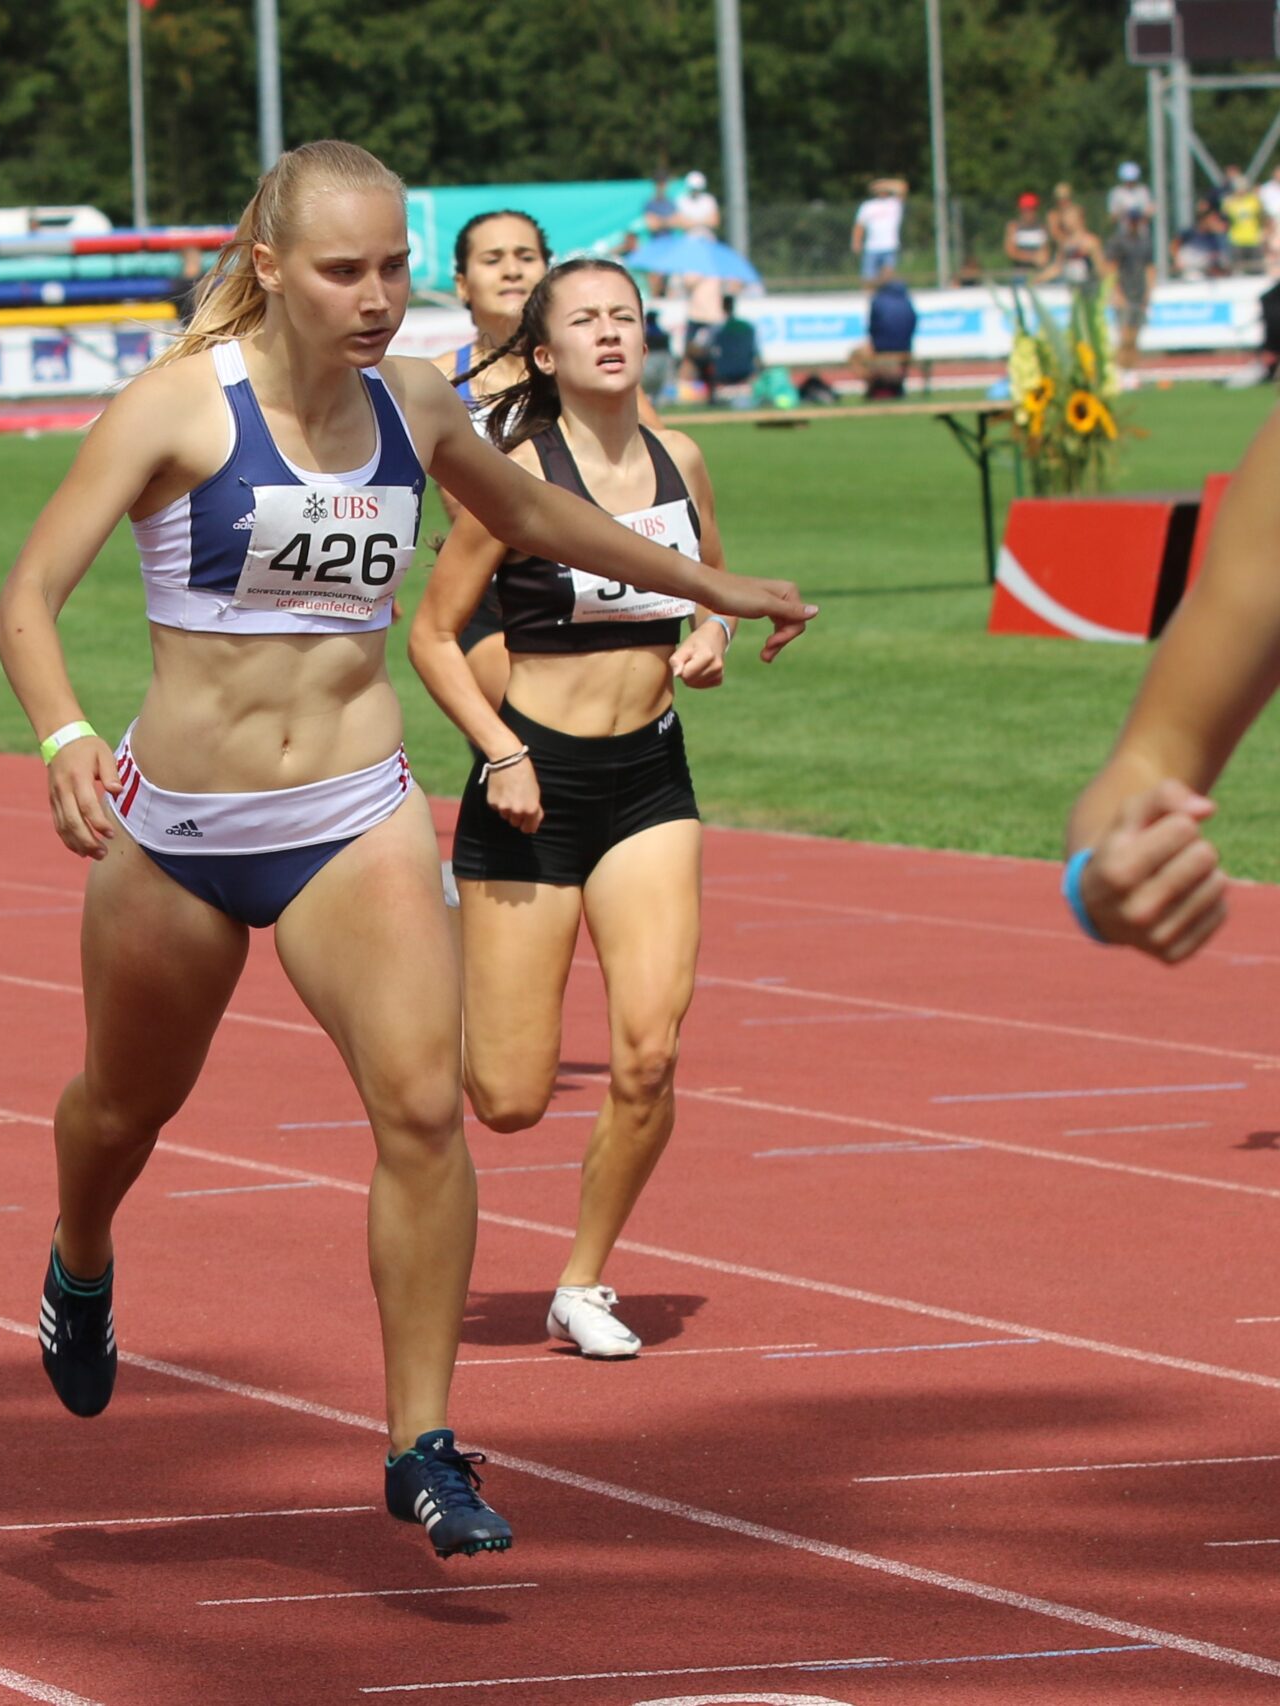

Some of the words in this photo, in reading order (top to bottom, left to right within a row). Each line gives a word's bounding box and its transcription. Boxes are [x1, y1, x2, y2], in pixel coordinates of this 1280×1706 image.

[331, 496, 379, 519] UBS
[232, 521, 256, 530] adid
[269, 532, 398, 586] 426
[165, 828, 203, 838] adidas
